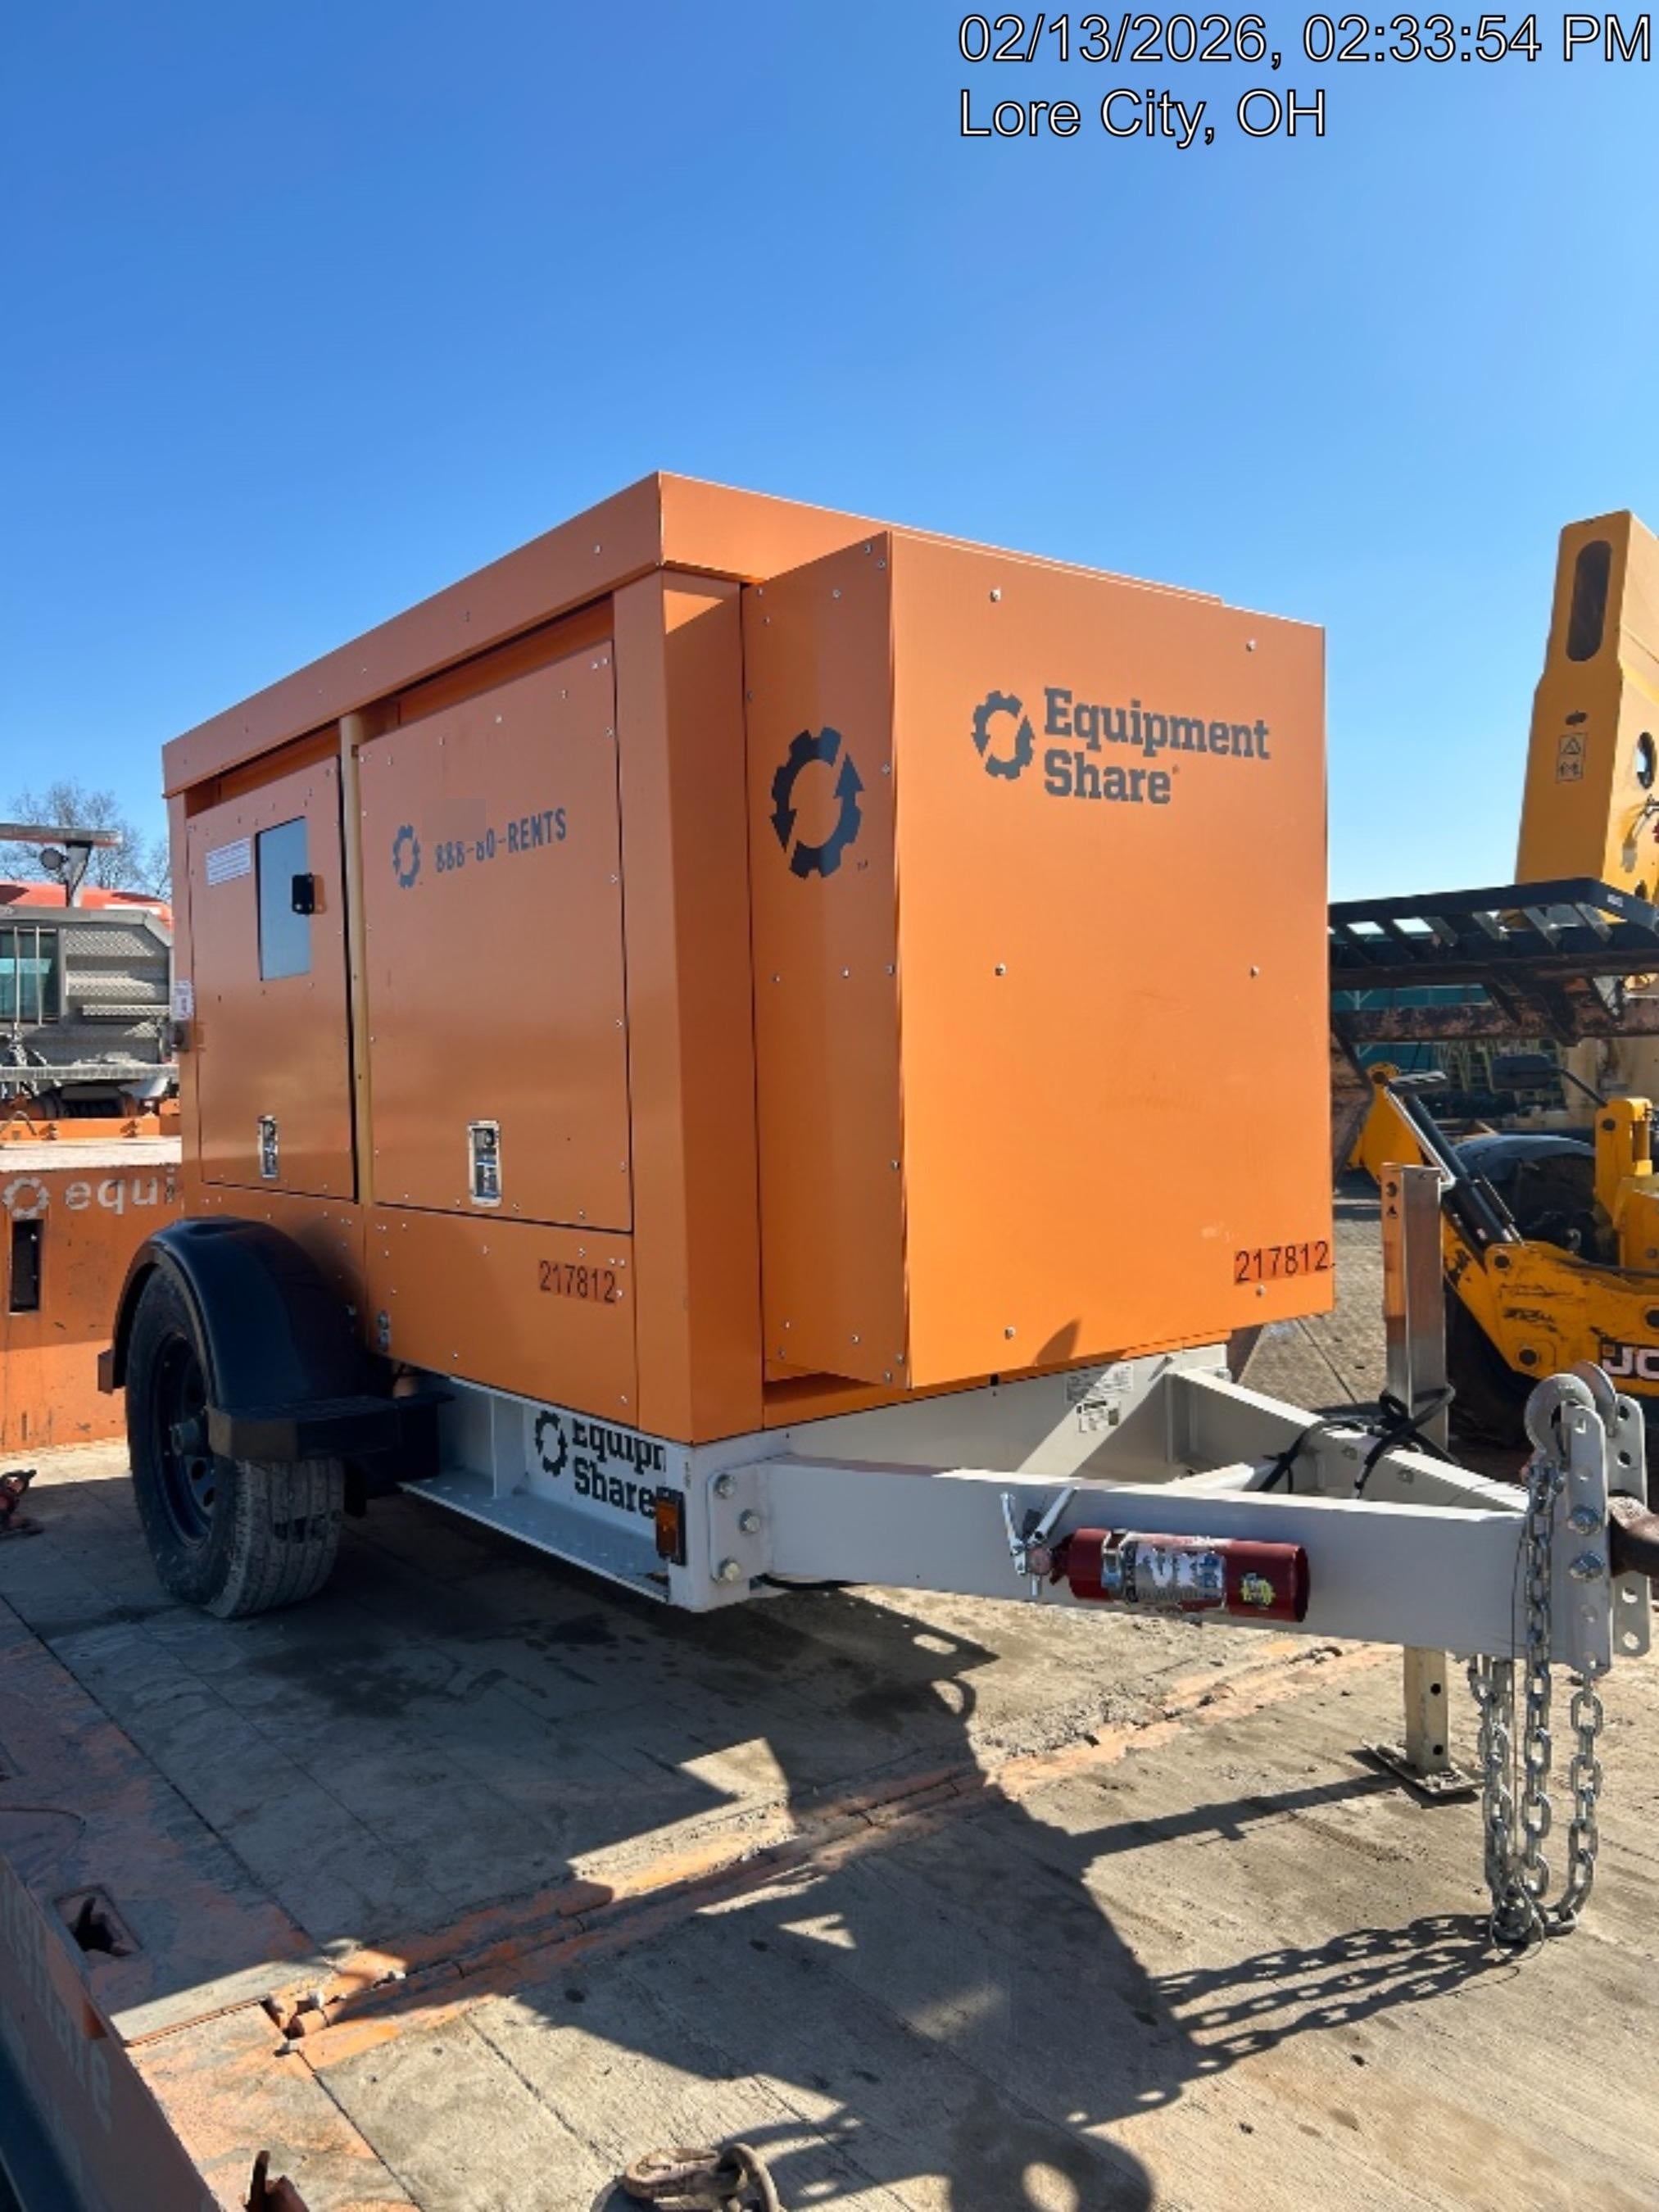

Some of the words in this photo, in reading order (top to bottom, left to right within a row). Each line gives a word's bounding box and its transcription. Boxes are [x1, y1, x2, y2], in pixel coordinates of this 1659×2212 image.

[1044, 686, 1271, 760] Equipment
[1044, 748, 1171, 805] Share
[65, 1167, 176, 1215] equi
[539, 1260, 615, 1304] 217812
[1235, 1240, 1329, 1284] 217812
[574, 1457, 656, 1519] Share
